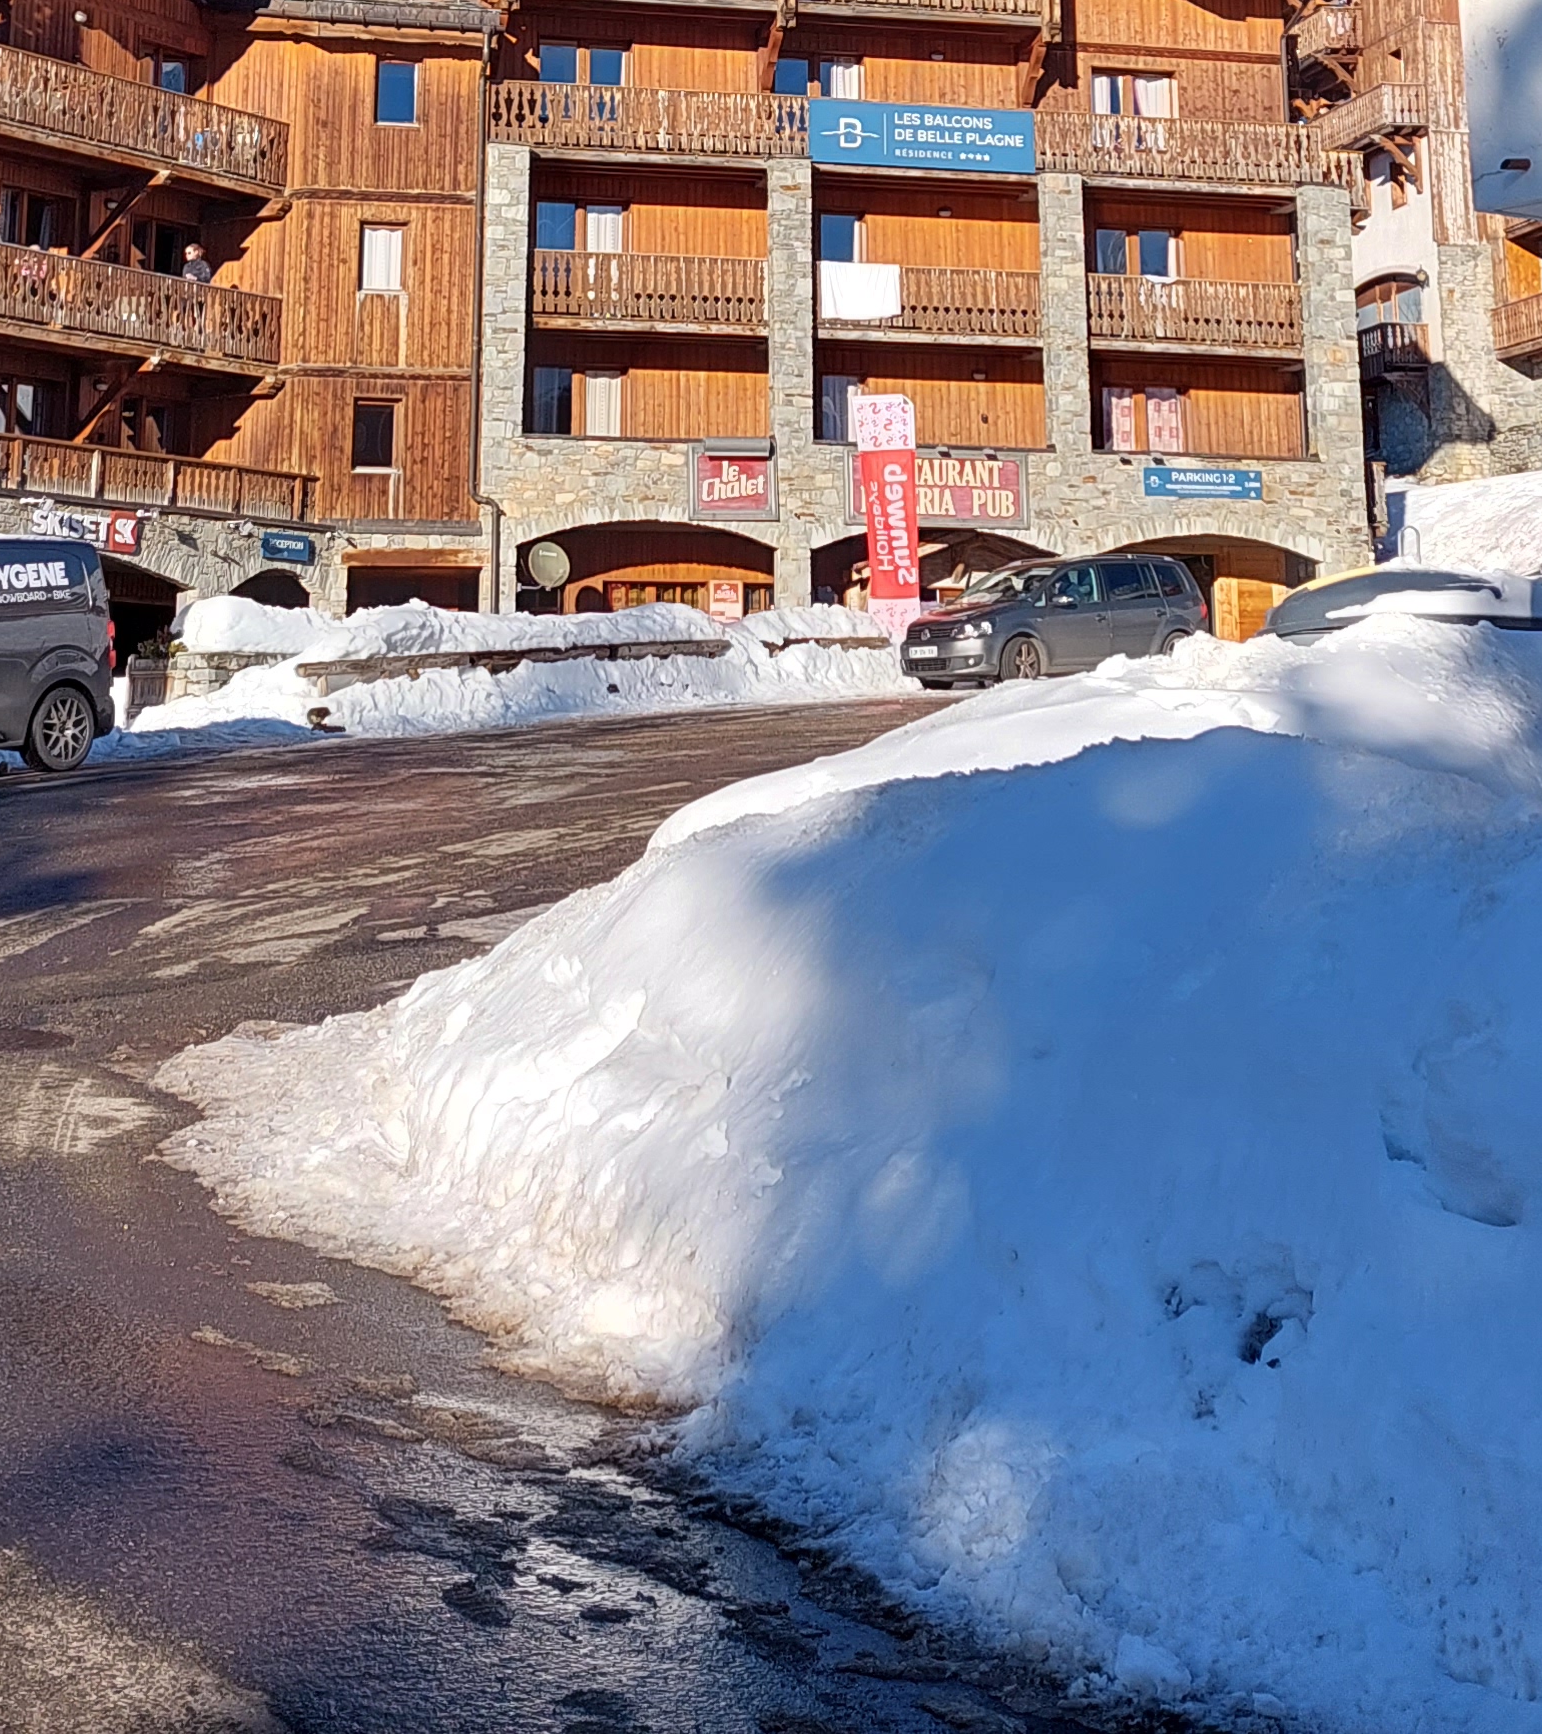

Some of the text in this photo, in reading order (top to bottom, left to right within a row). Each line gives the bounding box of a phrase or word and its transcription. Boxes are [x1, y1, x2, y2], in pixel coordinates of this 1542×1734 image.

[894, 112, 993, 129] LES BALCONS
[894, 129, 1024, 147] DE BELLE PLAGNE
[894, 148, 954, 160] RÉSIDENCE
[721, 460, 740, 483] le
[915, 458, 1003, 488] TAURANT
[1171, 471, 1221, 484] PARKING
[701, 474, 765, 502] Chalet
[972, 489, 1016, 517] PUB
[31, 509, 112, 542] SKISET
[53, 589, 72, 600] BIKE
